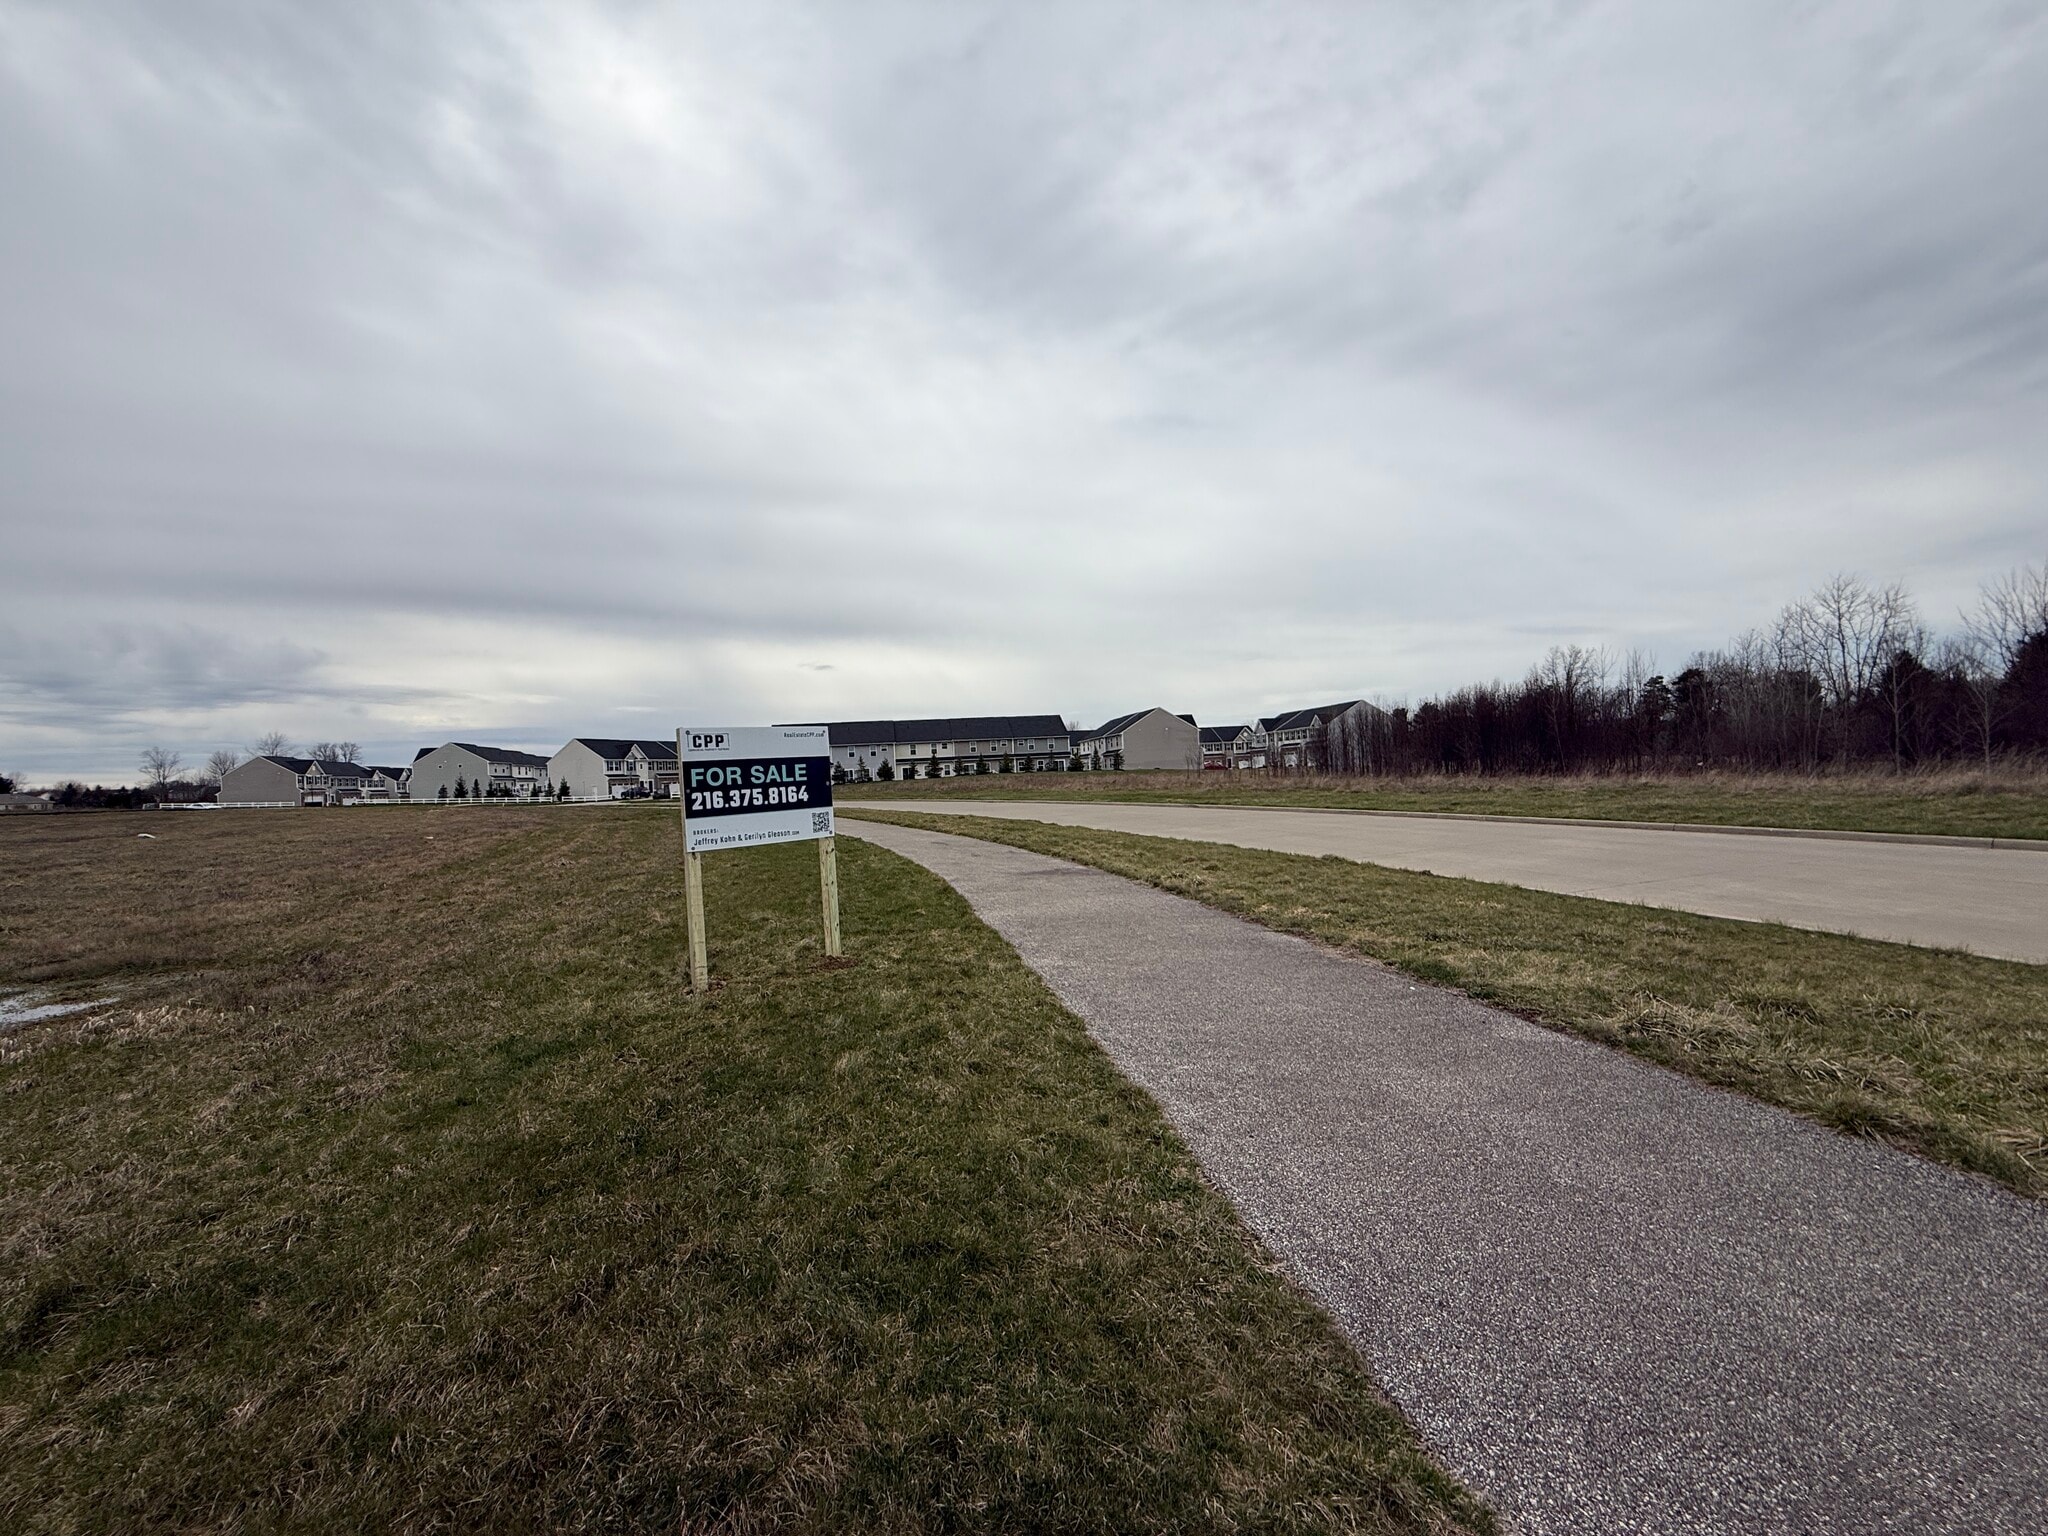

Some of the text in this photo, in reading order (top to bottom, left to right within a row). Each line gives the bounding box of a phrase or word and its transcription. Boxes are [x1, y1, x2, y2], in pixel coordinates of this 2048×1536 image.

[692, 735, 725, 748] CPP
[691, 764, 807, 787] FOR SALE
[691, 786, 808, 810] 216.375.8164
[694, 837, 718, 846] Jeffrey
[768, 830, 790, 838] Gleason
